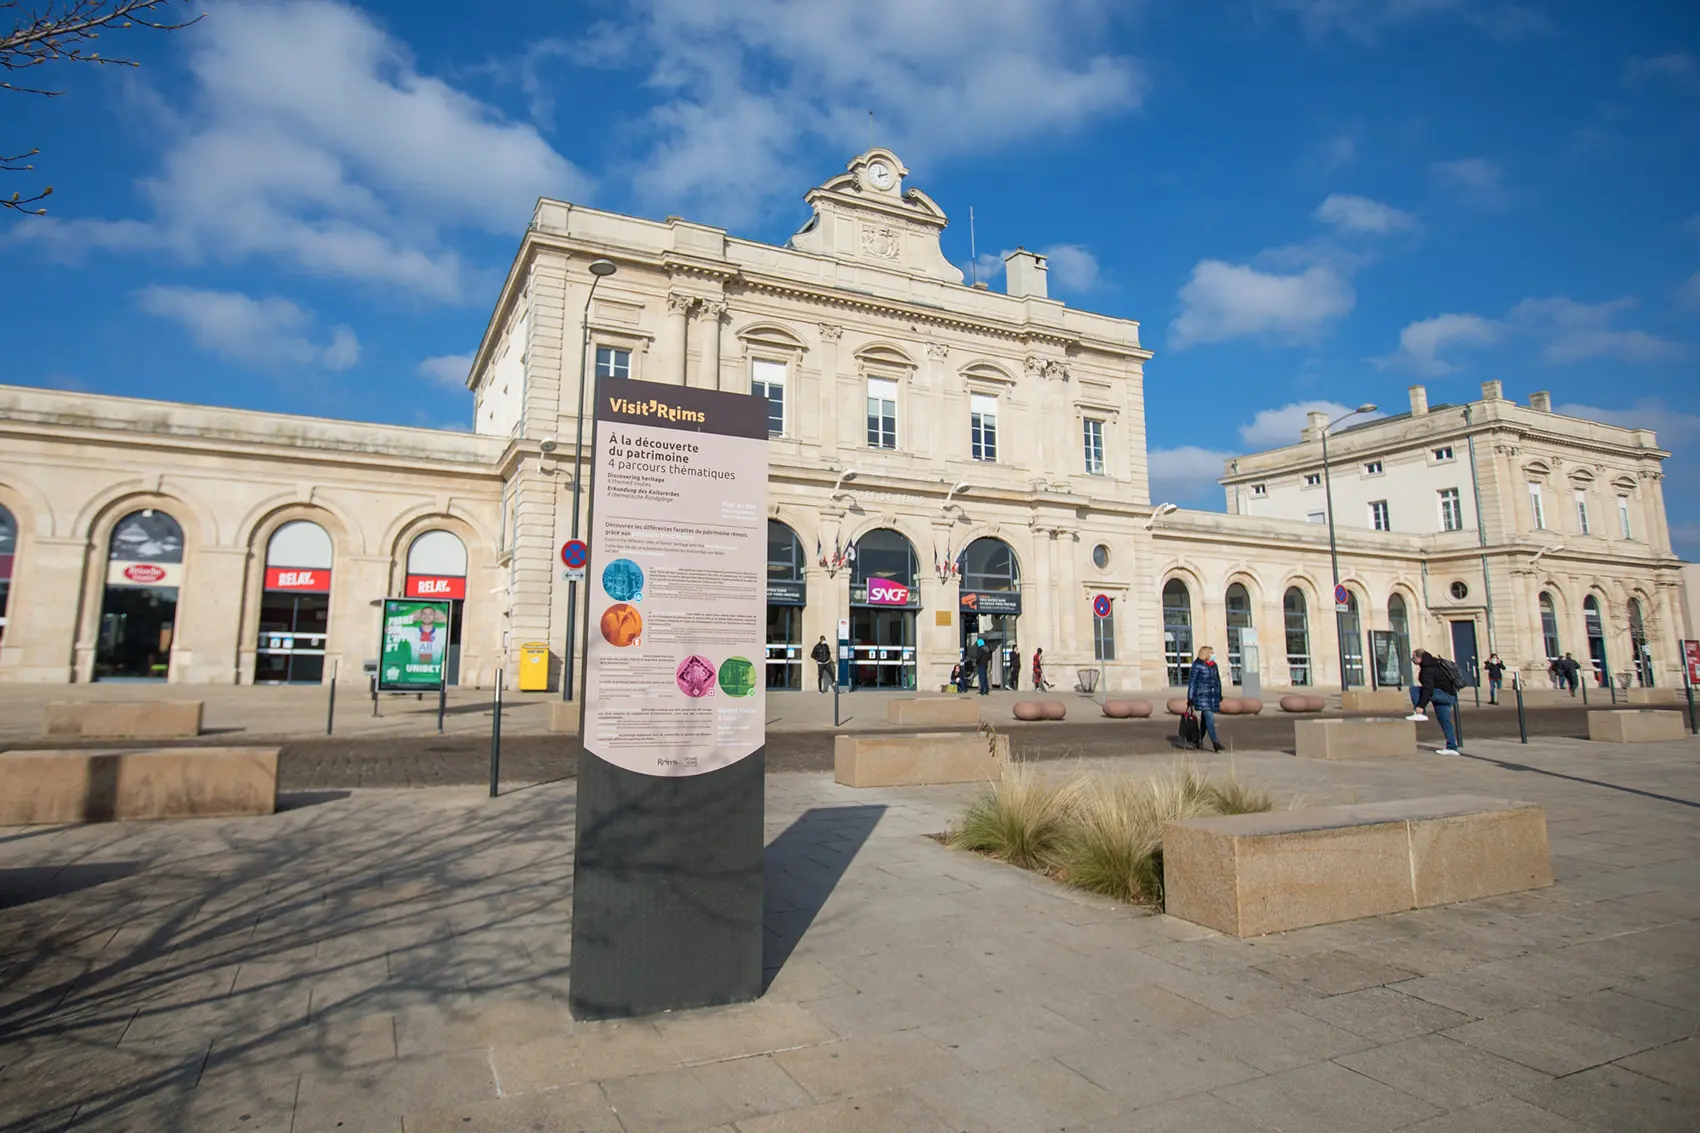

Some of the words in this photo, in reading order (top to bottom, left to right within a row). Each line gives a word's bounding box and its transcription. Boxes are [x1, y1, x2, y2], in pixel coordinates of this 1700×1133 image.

[609, 432, 618, 445] À
[621, 434, 632, 446] la
[635, 437, 699, 453] découverte
[608, 446, 623, 457] du
[626, 448, 690, 464] patrimoine
[608, 458, 615, 468] 4
[618, 460, 666, 474] parcours
[669, 464, 736, 480] thématiques
[608, 472, 640, 481] Discovering
[870, 588, 907, 601] SNCF
[406, 664, 440, 673] UNIBET
